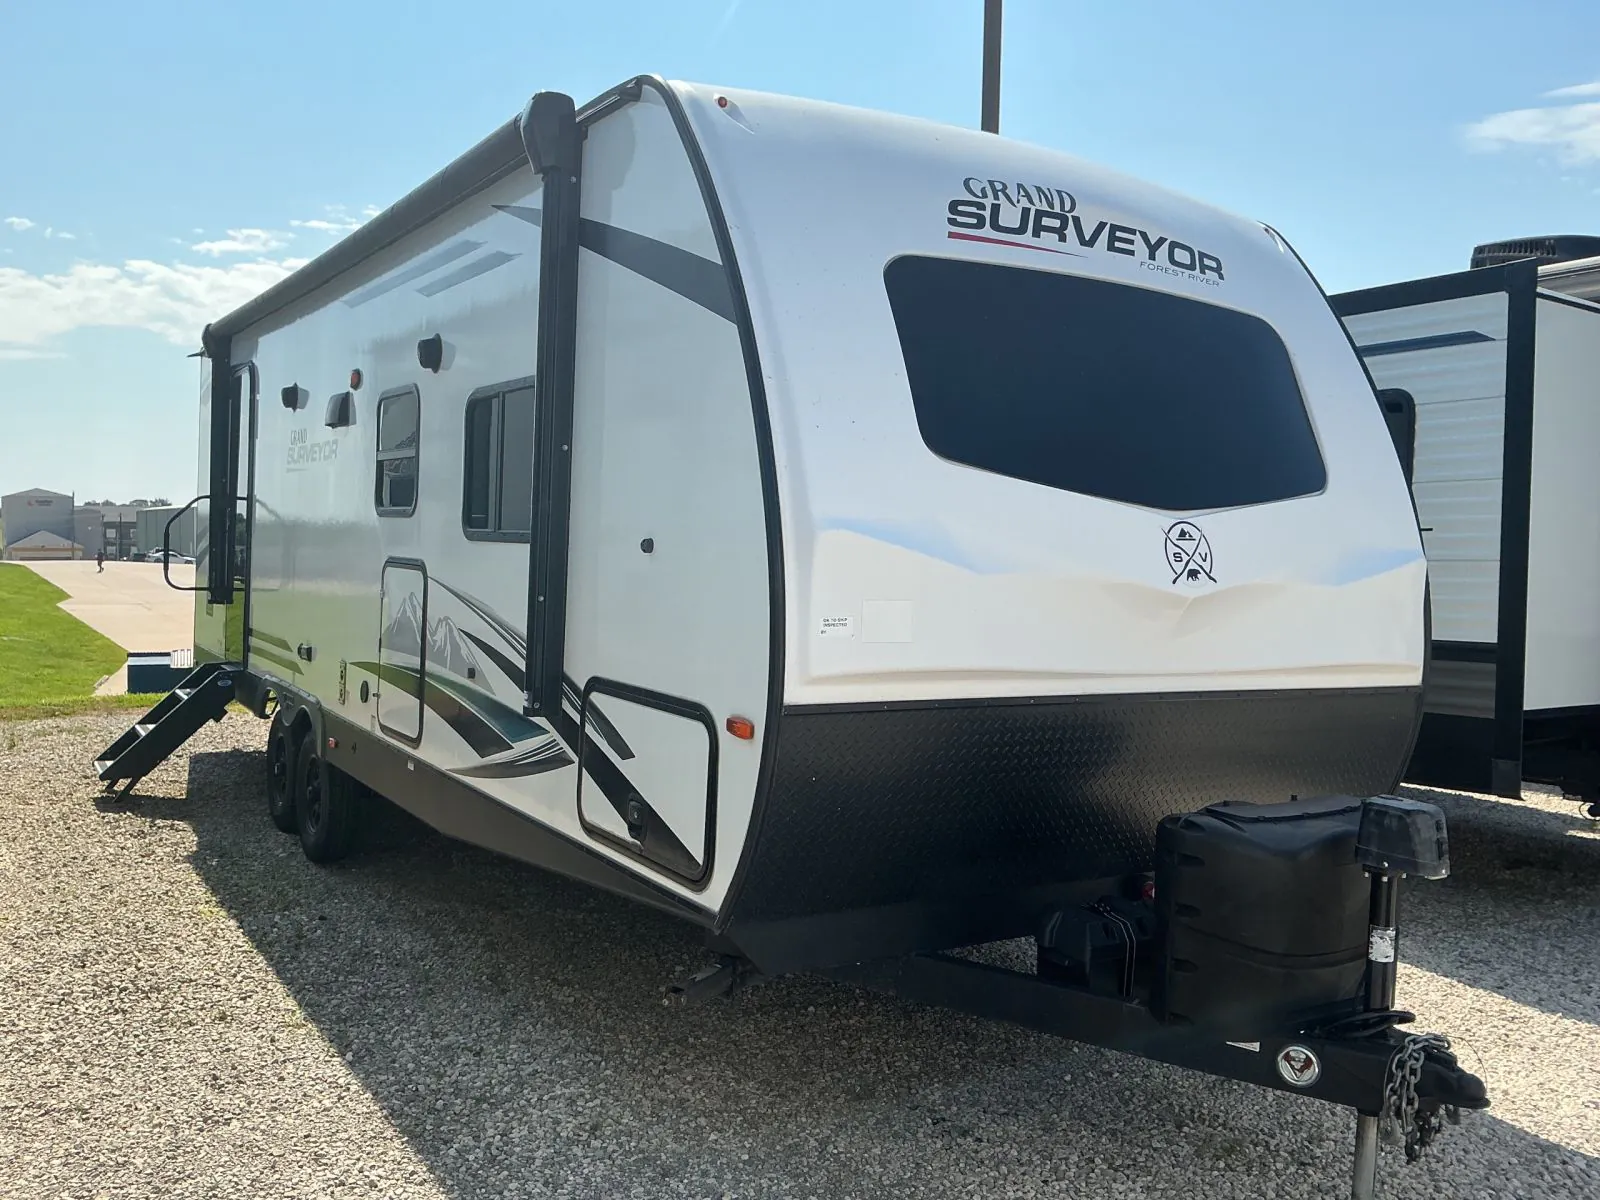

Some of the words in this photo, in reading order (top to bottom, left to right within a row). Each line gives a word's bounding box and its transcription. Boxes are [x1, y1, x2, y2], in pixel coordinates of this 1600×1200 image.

[963, 177, 1077, 214] GRAND
[947, 199, 1225, 281] SURVEYOR
[1139, 261, 1185, 279] FOREST
[1188, 273, 1220, 287] RIVER
[290, 429, 308, 446] GRAND
[286, 439, 339, 465] SURVEYOR
[1173, 552, 1183, 562] S
[1198, 552, 1207, 562] V
